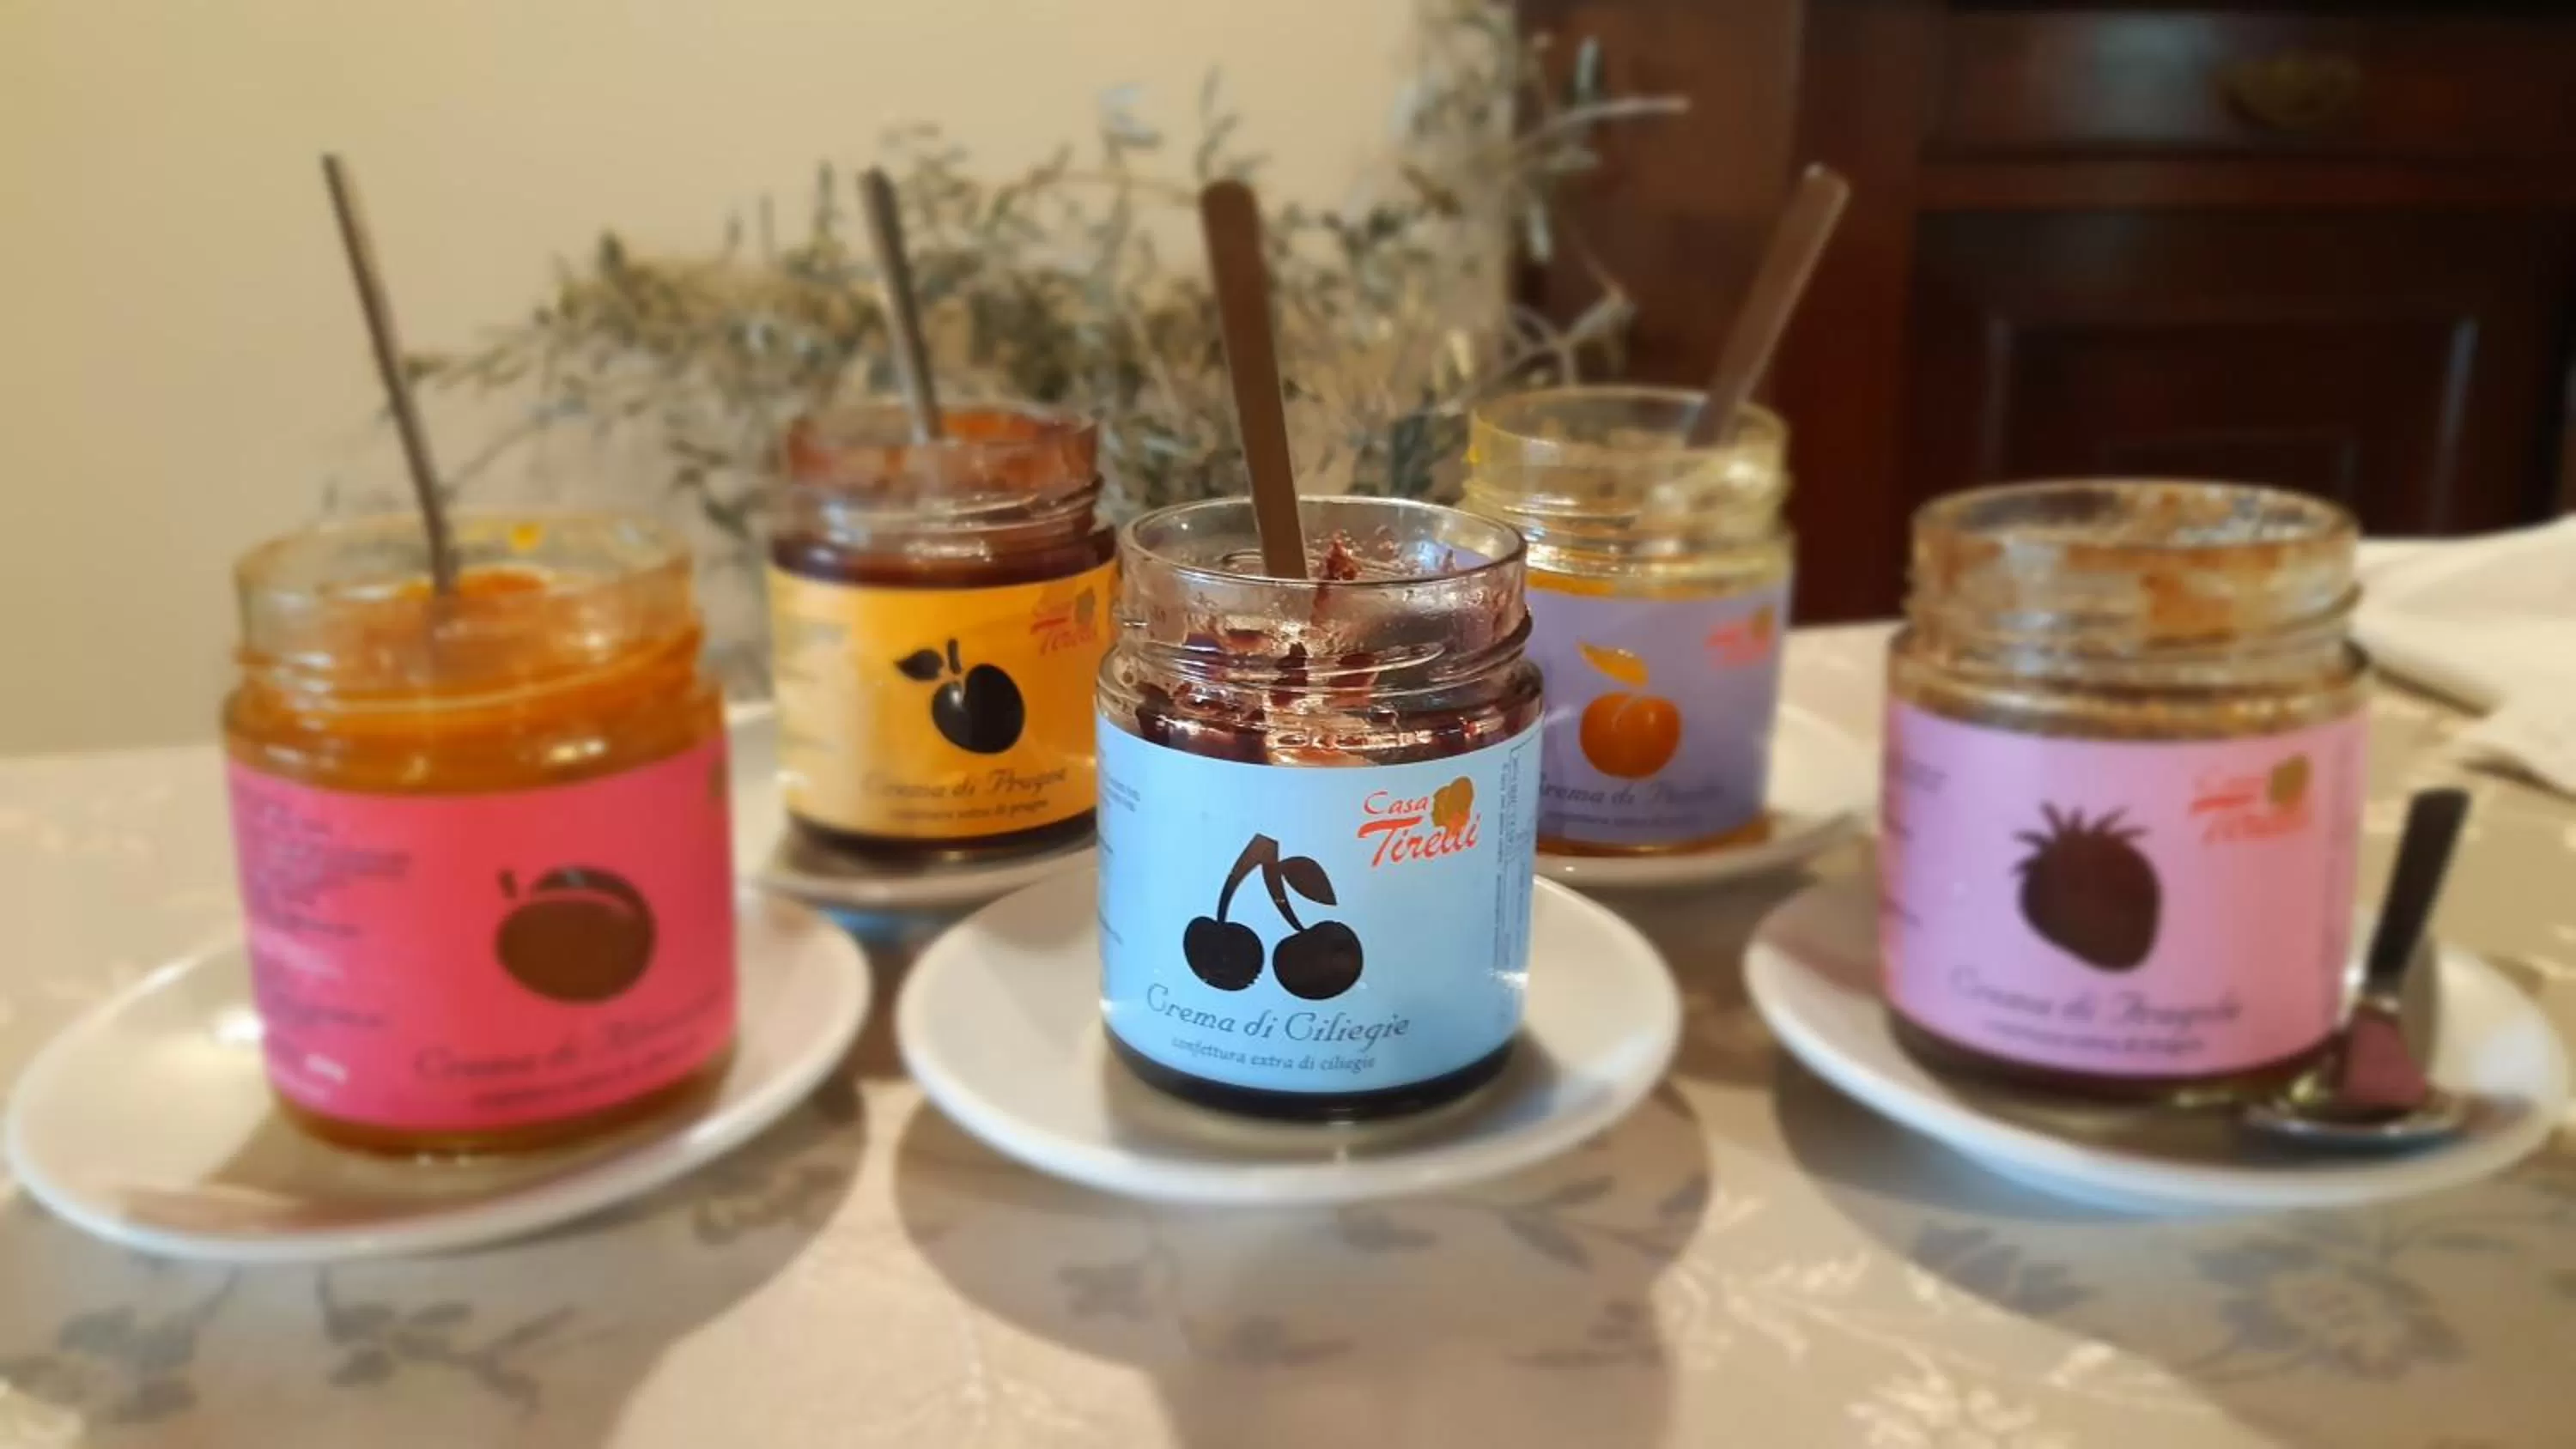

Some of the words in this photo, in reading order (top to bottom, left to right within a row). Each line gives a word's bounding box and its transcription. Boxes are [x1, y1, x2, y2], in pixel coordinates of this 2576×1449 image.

[1364, 790, 1430, 815] Casa
[1357, 811, 1482, 868] Tirelli
[1146, 983, 1236, 1033] Crema
[1243, 1009, 1279, 1039] di
[1285, 1011, 1411, 1053] Ciliegie
[1249, 1054, 1293, 1070] extra
[1297, 1054, 1315, 1070] di
